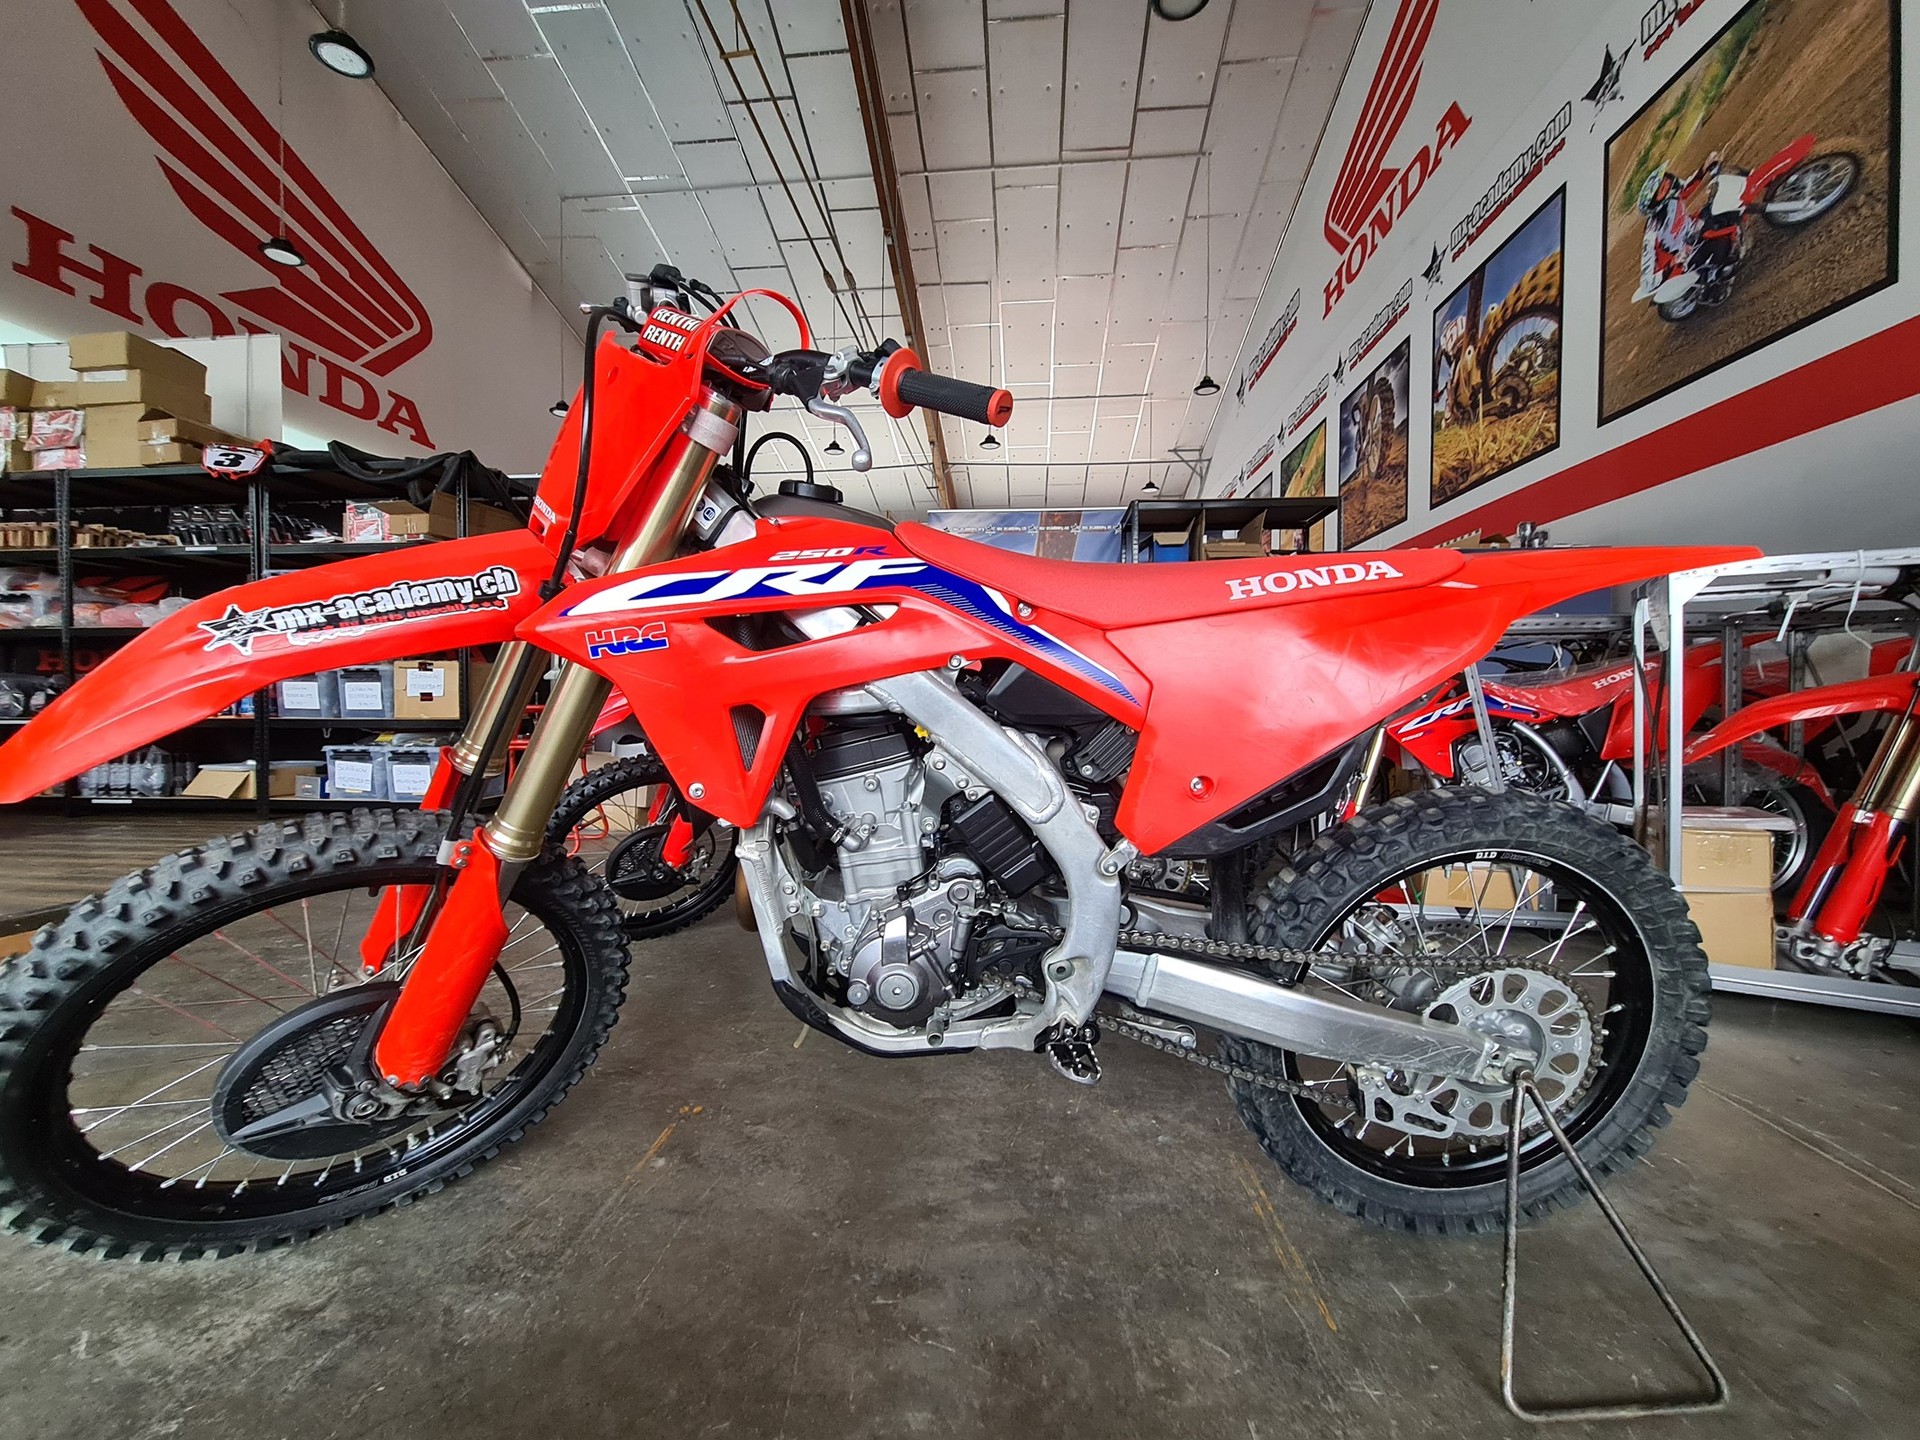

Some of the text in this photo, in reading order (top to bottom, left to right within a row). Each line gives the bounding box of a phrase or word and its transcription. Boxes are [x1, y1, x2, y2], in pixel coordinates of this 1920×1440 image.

[1450, 101, 1572, 251] mx-academy.com
[1322, 101, 1473, 320] HONDA
[652, 308, 703, 332] RENTH
[212, 452, 247, 468] 3
[534, 495, 557, 525] HONDA
[768, 546, 895, 562] 250R
[566, 557, 930, 617] CRF
[1224, 560, 1404, 601] HONDA
[273, 569, 516, 632] mx-academy.ch
[585, 621, 670, 660] HRC
[1592, 661, 1660, 690] HONA
[1397, 695, 1472, 734] CRF
